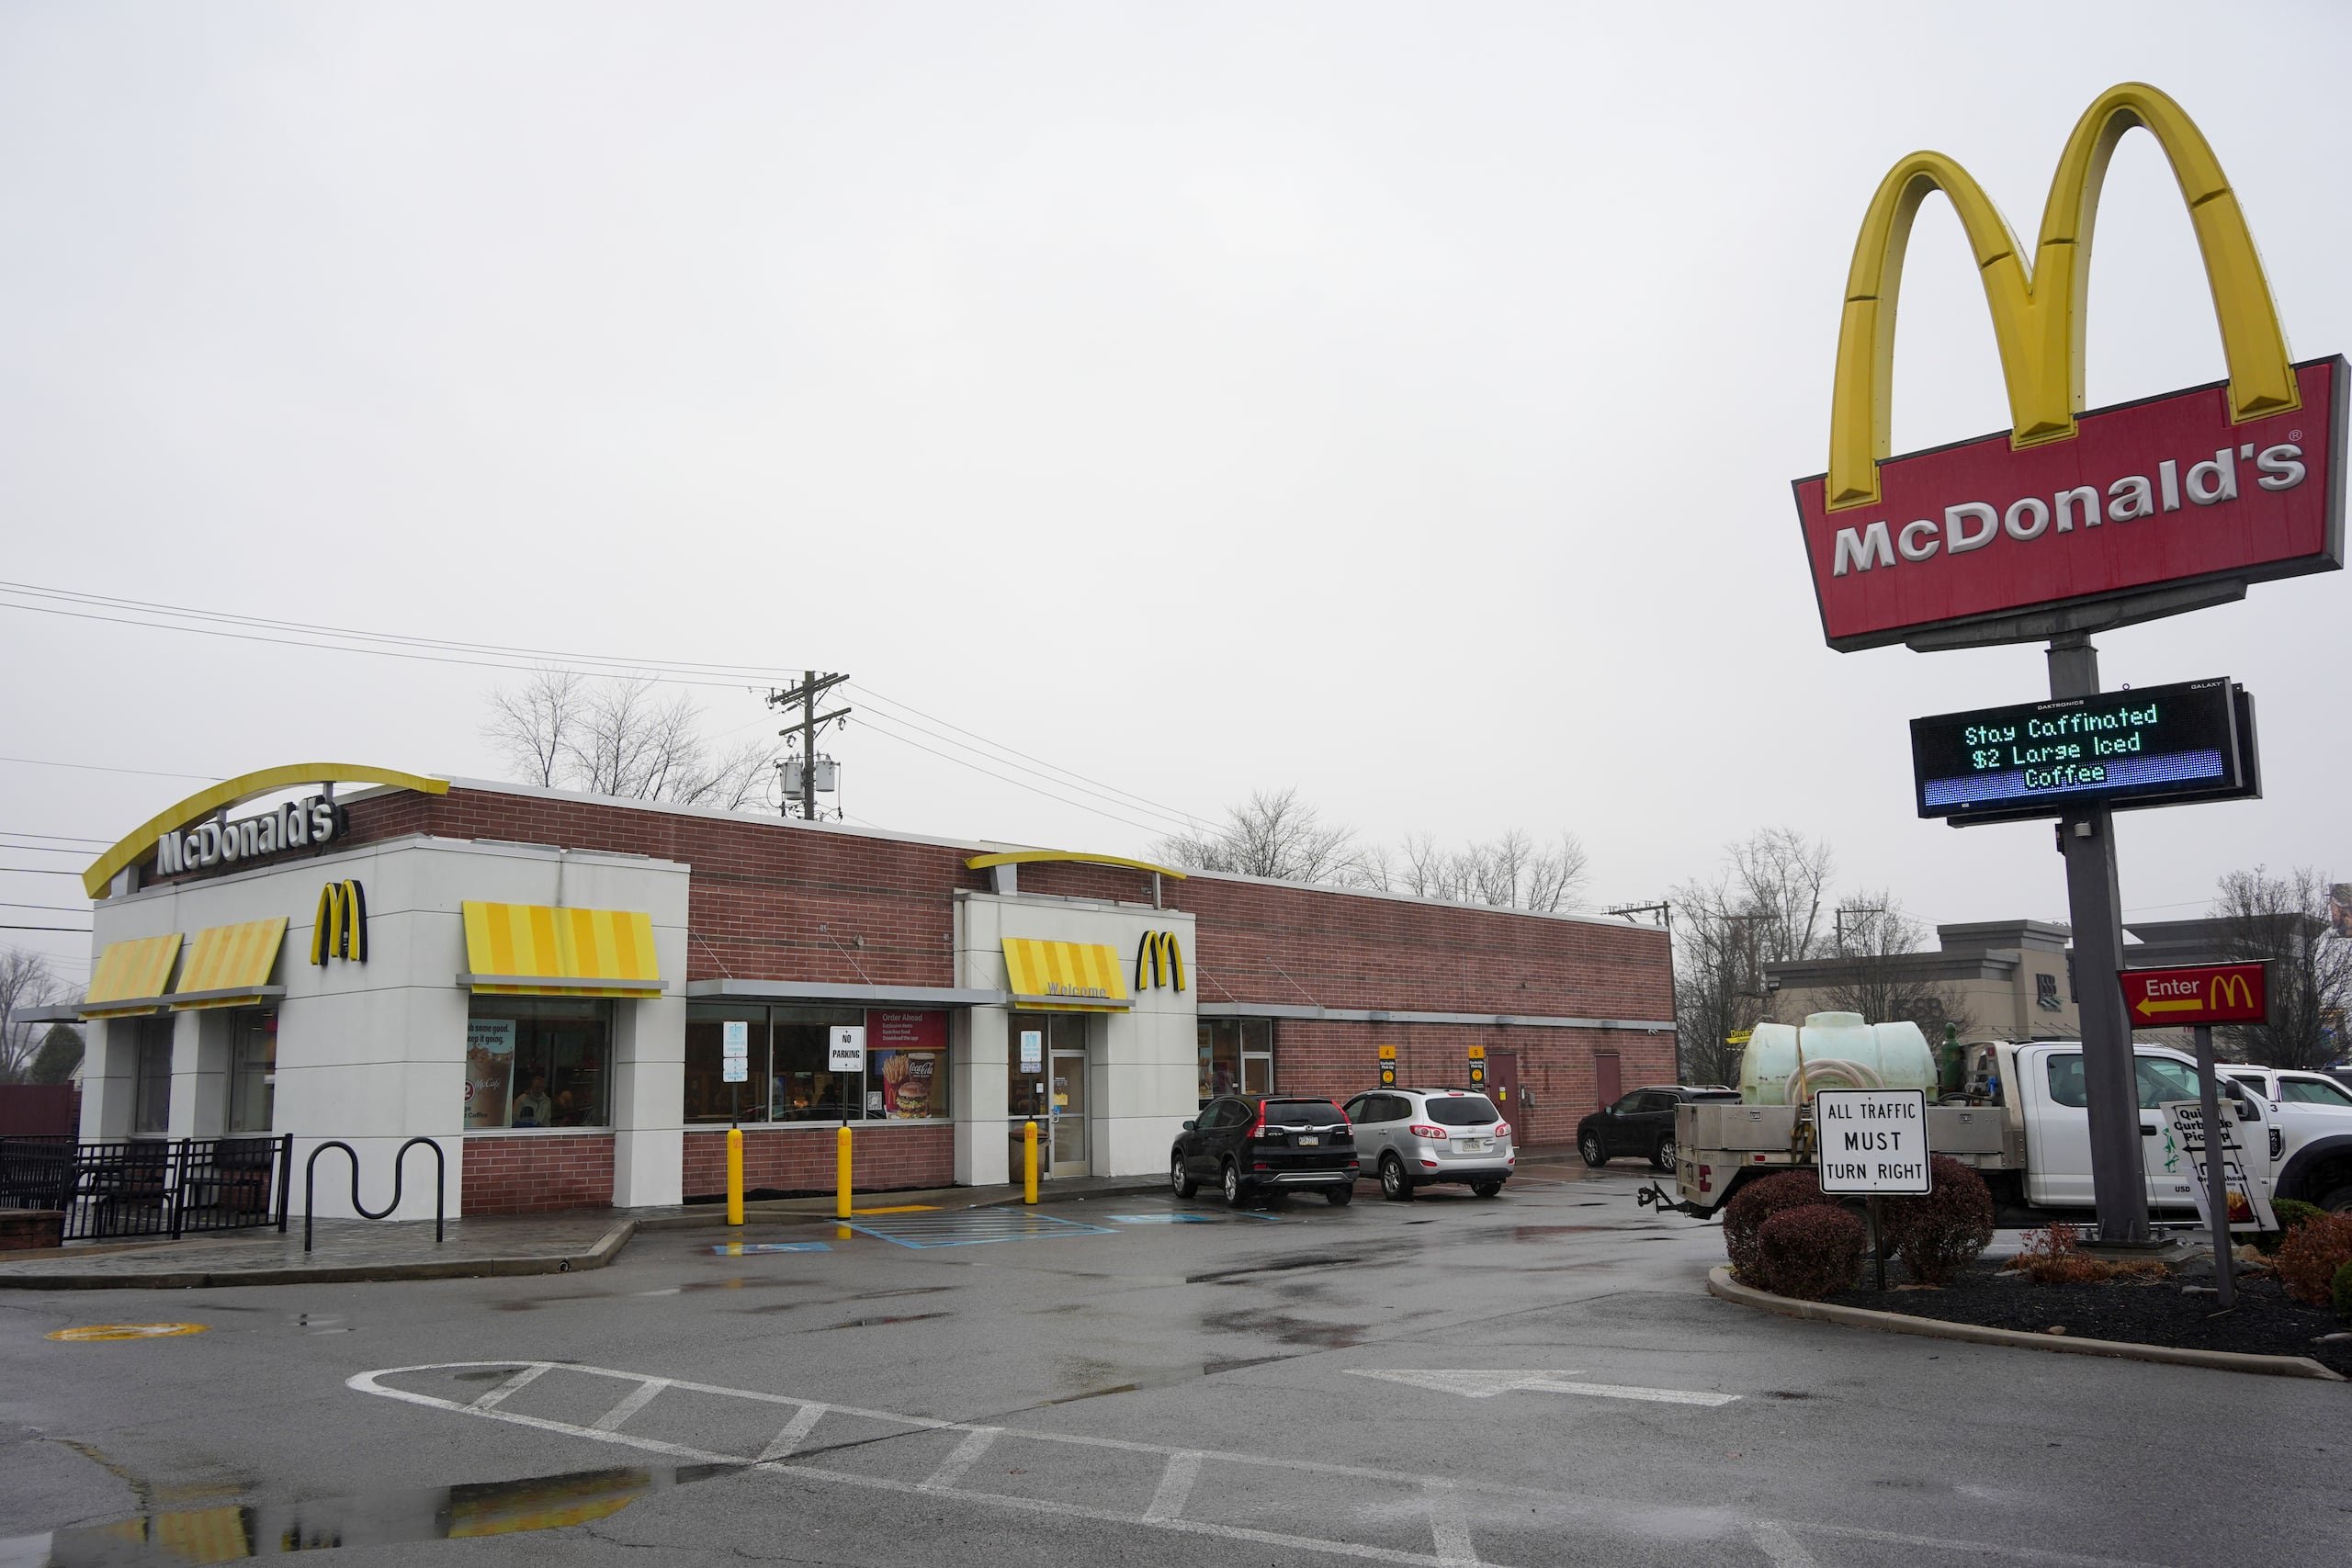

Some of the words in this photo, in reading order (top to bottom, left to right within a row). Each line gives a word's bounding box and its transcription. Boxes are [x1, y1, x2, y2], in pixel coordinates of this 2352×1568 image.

[1832, 443, 2307, 577] McDonald's
[2190, 681, 2222, 690] GALAXY
[2037, 699, 2085, 711] DAKTRONICS
[1965, 725, 2016, 746] Stay
[2028, 704, 2157, 738] Caffinated
[1973, 748, 2000, 769] $2
[2013, 742, 2081, 765] Large
[2094, 732, 2141, 756] Iced
[2024, 763, 2106, 788] Coffee
[156, 796, 334, 875] McDonald's
[1047, 981, 1107, 998] Welcome
[2145, 978, 2200, 997] Enter
[882, 1013, 901, 1021] Order
[901, 1013, 923, 1021] Ahead
[480, 1034, 485, 1043] it
[842, 1034, 852, 1043] NO
[832, 1049, 860, 1059] PARKING
[1828, 1104, 1853, 1119] ALL
[1860, 1103, 1916, 1119] TRAFFIC
[2173, 1120, 2233, 1131] Curbde
[1844, 1132, 1902, 1151] MUST
[2184, 1131, 2231, 1143] Picp
[1826, 1163, 1867, 1179] TURN
[1878, 1163, 1922, 1179] RIGHT
